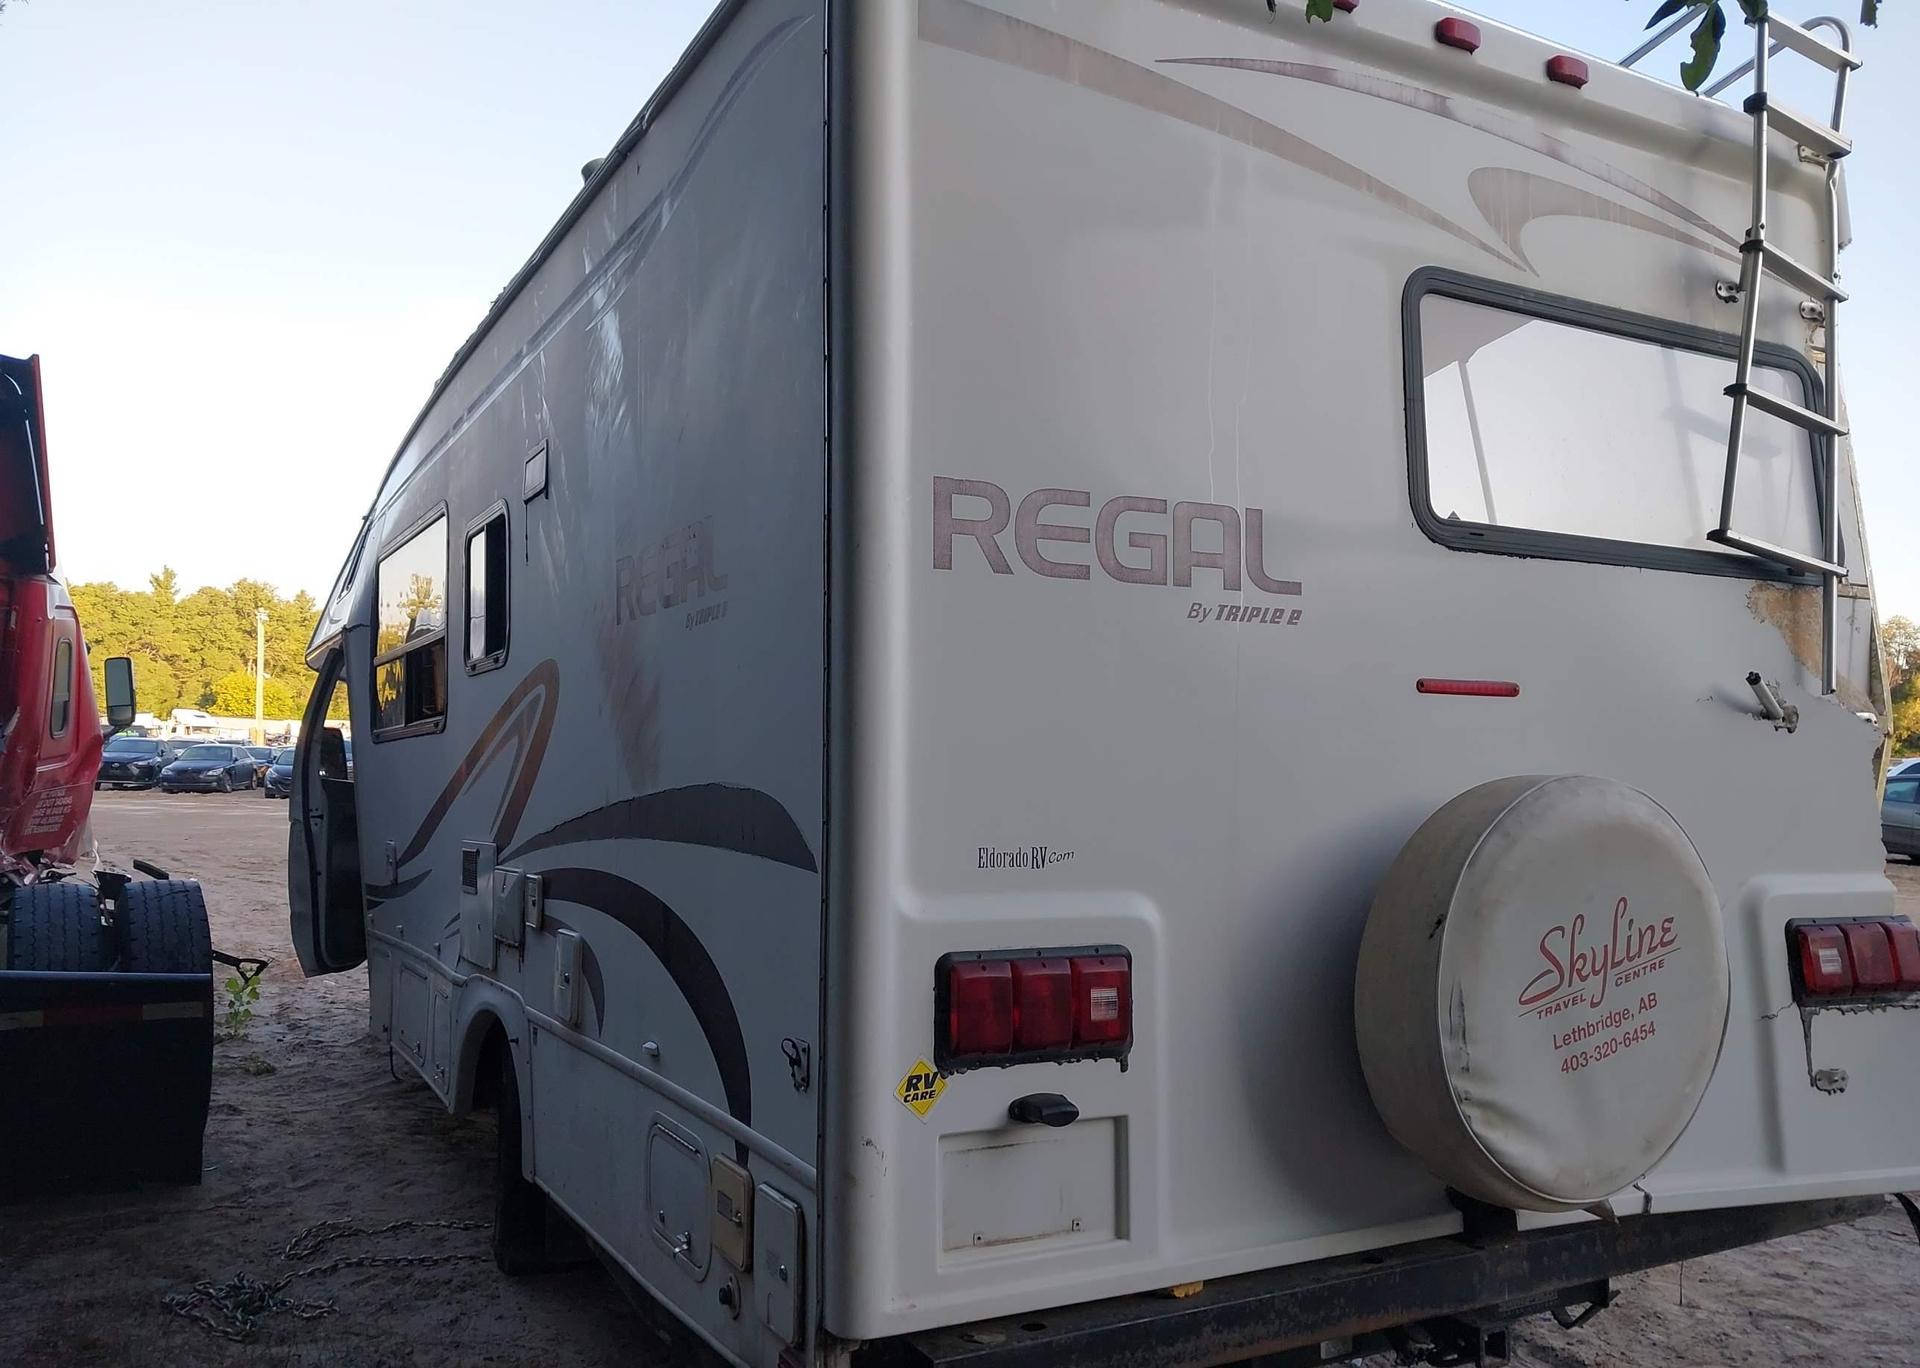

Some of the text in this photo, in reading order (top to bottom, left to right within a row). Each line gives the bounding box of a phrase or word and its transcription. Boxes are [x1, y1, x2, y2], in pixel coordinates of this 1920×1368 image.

[933, 475, 1302, 596] REGAL
[1187, 602, 1212, 623] By
[978, 847, 1028, 868] Eldorado
[1536, 959, 1665, 1020] TRAVEL CENTRE
[1552, 992, 1658, 1050] Lethbridge, AB
[1560, 1021, 1657, 1074] 403-320-6454
[903, 1089, 936, 1104] CARE
[905, 1072, 939, 1093] RV
